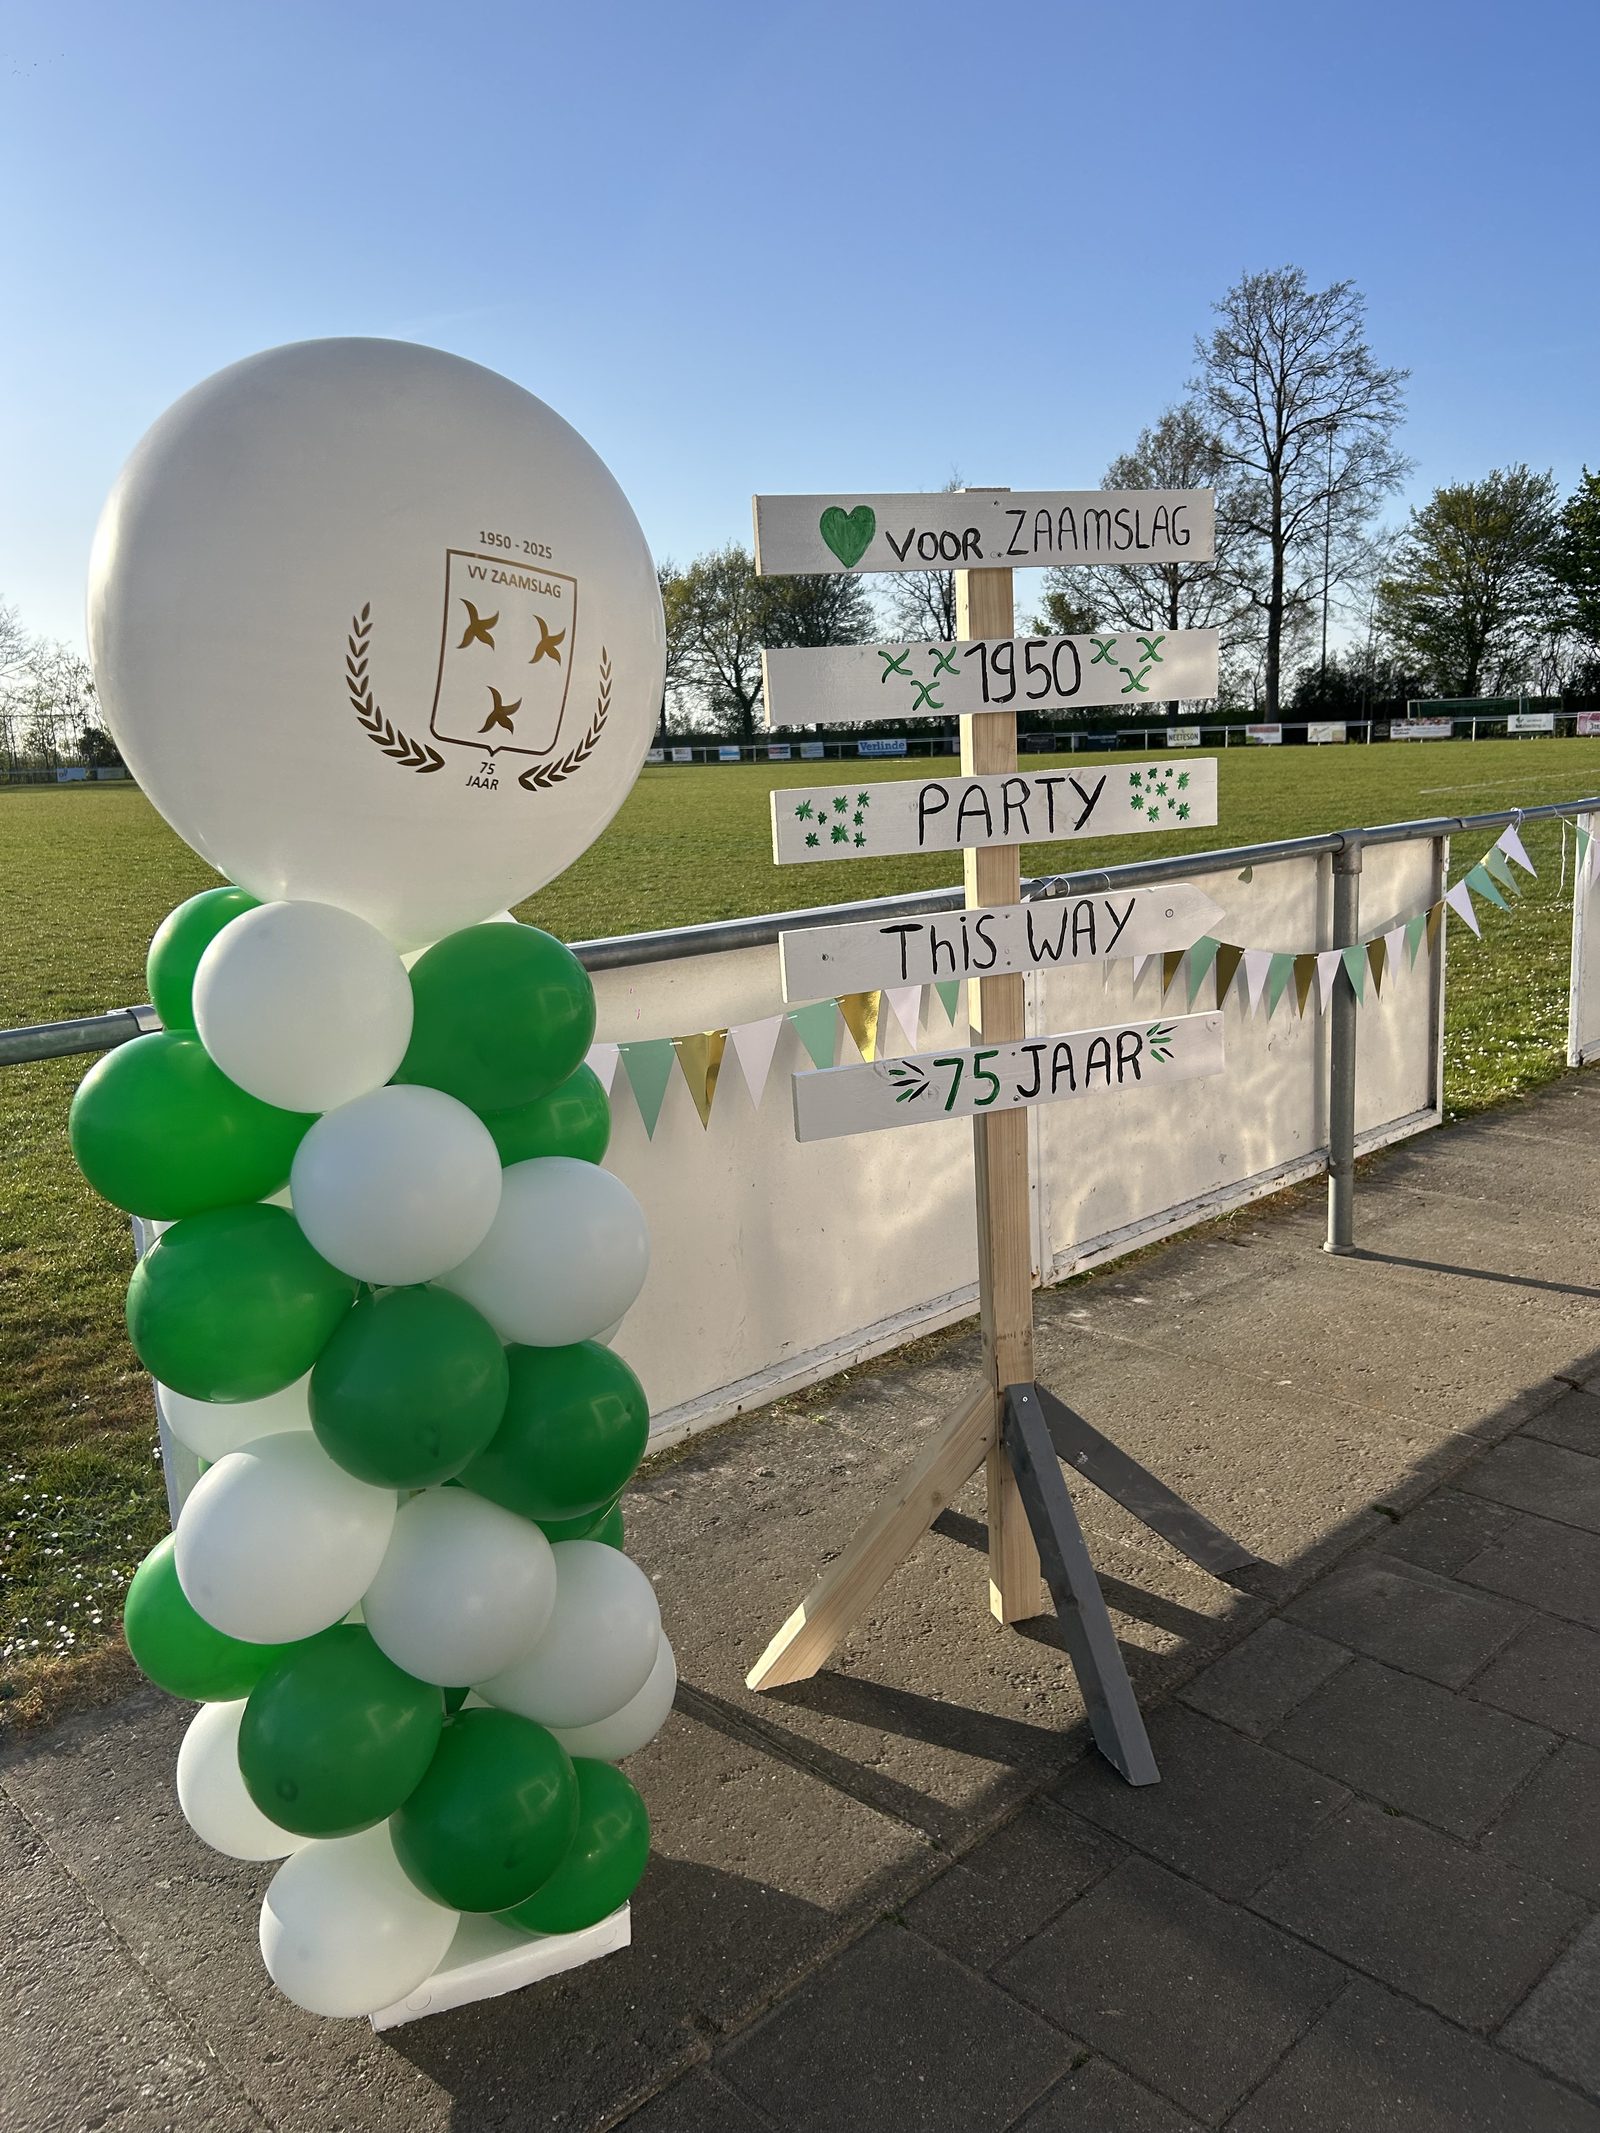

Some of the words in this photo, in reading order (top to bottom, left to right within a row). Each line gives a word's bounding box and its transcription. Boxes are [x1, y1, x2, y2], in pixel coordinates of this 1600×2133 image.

[479, 530, 511, 549] 1950
[523, 540, 553, 559] 2025
[885, 526, 984, 563] VOOR
[1005, 505, 1191, 556] ZAAMSLAG
[467, 564, 487, 581] VV
[491, 569, 562, 598] ZAAMSLAG
[964, 639, 1082, 704] 1950
[479, 761, 496, 775] 75
[860, 740, 905, 751] Verlinde
[465, 775, 499, 790] JAAR
[918, 774, 1108, 846] PARTY
[1026, 897, 1136, 963] WAY
[932, 1050, 1001, 1112] 75
[1016, 1030, 1143, 1099] JAAR
